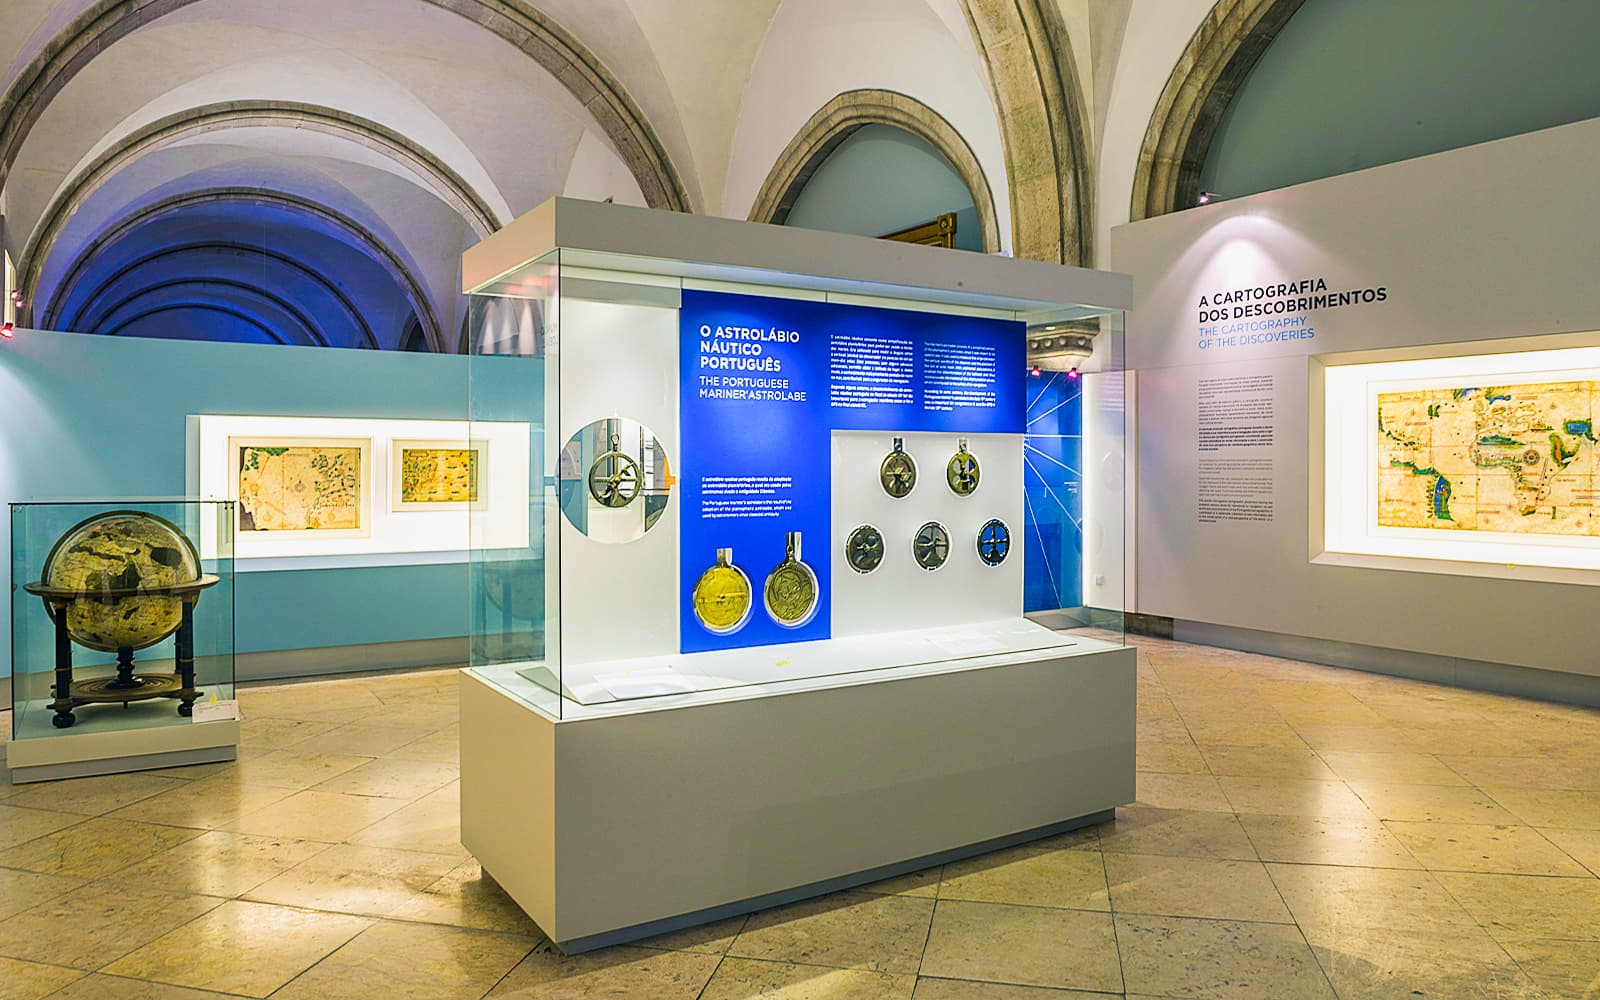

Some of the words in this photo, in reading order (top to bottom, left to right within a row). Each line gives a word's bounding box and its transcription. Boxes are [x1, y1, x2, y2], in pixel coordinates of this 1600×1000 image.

[1198, 295, 1209, 307] A
[1213, 278, 1327, 306] CARTOGRAFIA
[1199, 308, 1229, 323] DOS
[1233, 287, 1387, 319] DESCOBRIMENTOS
[700, 325, 711, 337] O
[714, 326, 800, 343] ASTROLÁBIO
[1199, 326, 1218, 337] THE
[1221, 315, 1307, 335] CARTOGRAPHY
[700, 339, 762, 356] NÁUTICO
[1198, 339, 1213, 350] OF
[1216, 336, 1236, 347] THE
[1239, 327, 1315, 346] DISCOVERIES
[700, 356, 781, 372] PORTUGUÊS
[699, 375, 720, 387] THE
[722, 376, 789, 389] PORTUGUESE
